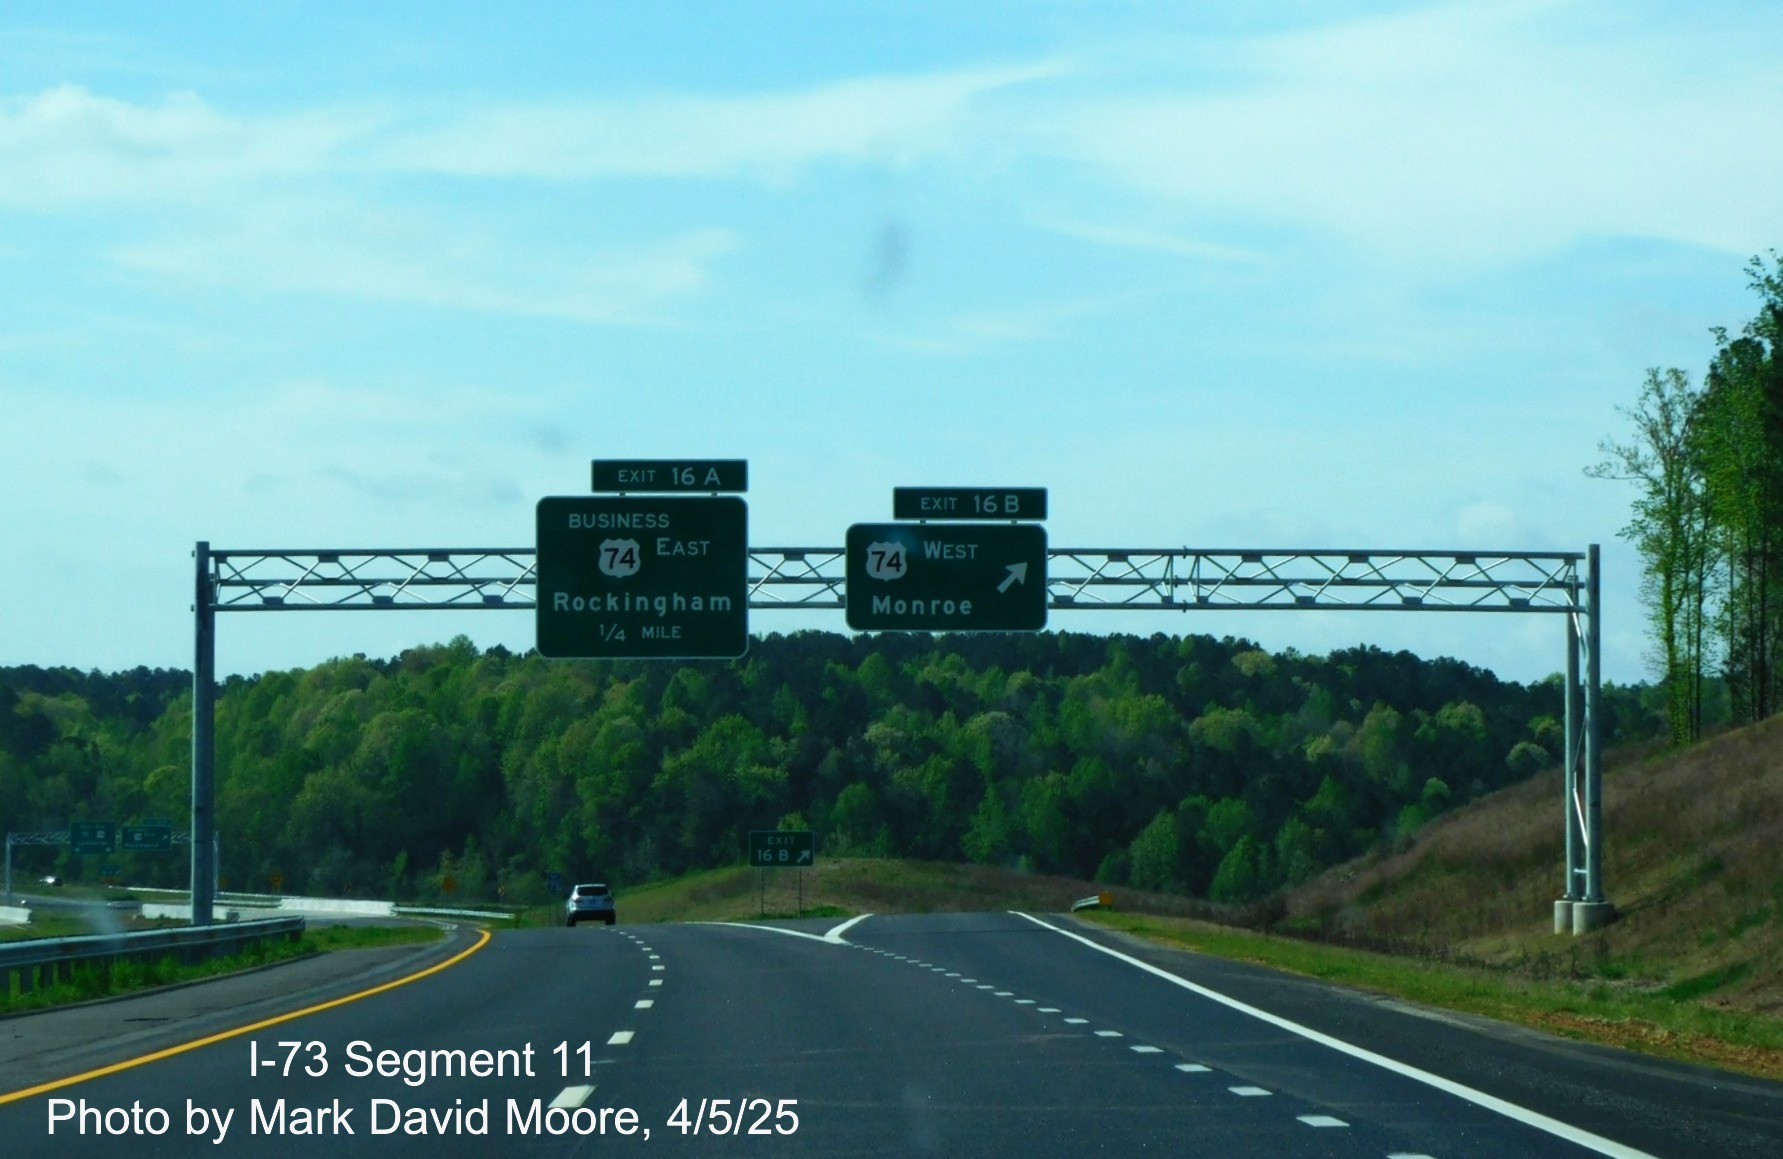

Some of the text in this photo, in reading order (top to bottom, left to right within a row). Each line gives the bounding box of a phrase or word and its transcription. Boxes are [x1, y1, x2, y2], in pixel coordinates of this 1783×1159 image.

[618, 467, 721, 485] EXIT 16 A
[921, 495, 1020, 513] EXIT 16 B
[568, 513, 670, 529] BUSINESS
[604, 537, 710, 569] 74 EAST
[871, 541, 978, 572] 74 WEST
[554, 592, 731, 617] Rockingham
[872, 595, 973, 615] Monroe
[599, 623, 682, 642] 1/4 MILE
[767, 836, 795, 845] EXIT
[757, 849, 789, 862] 16 B
